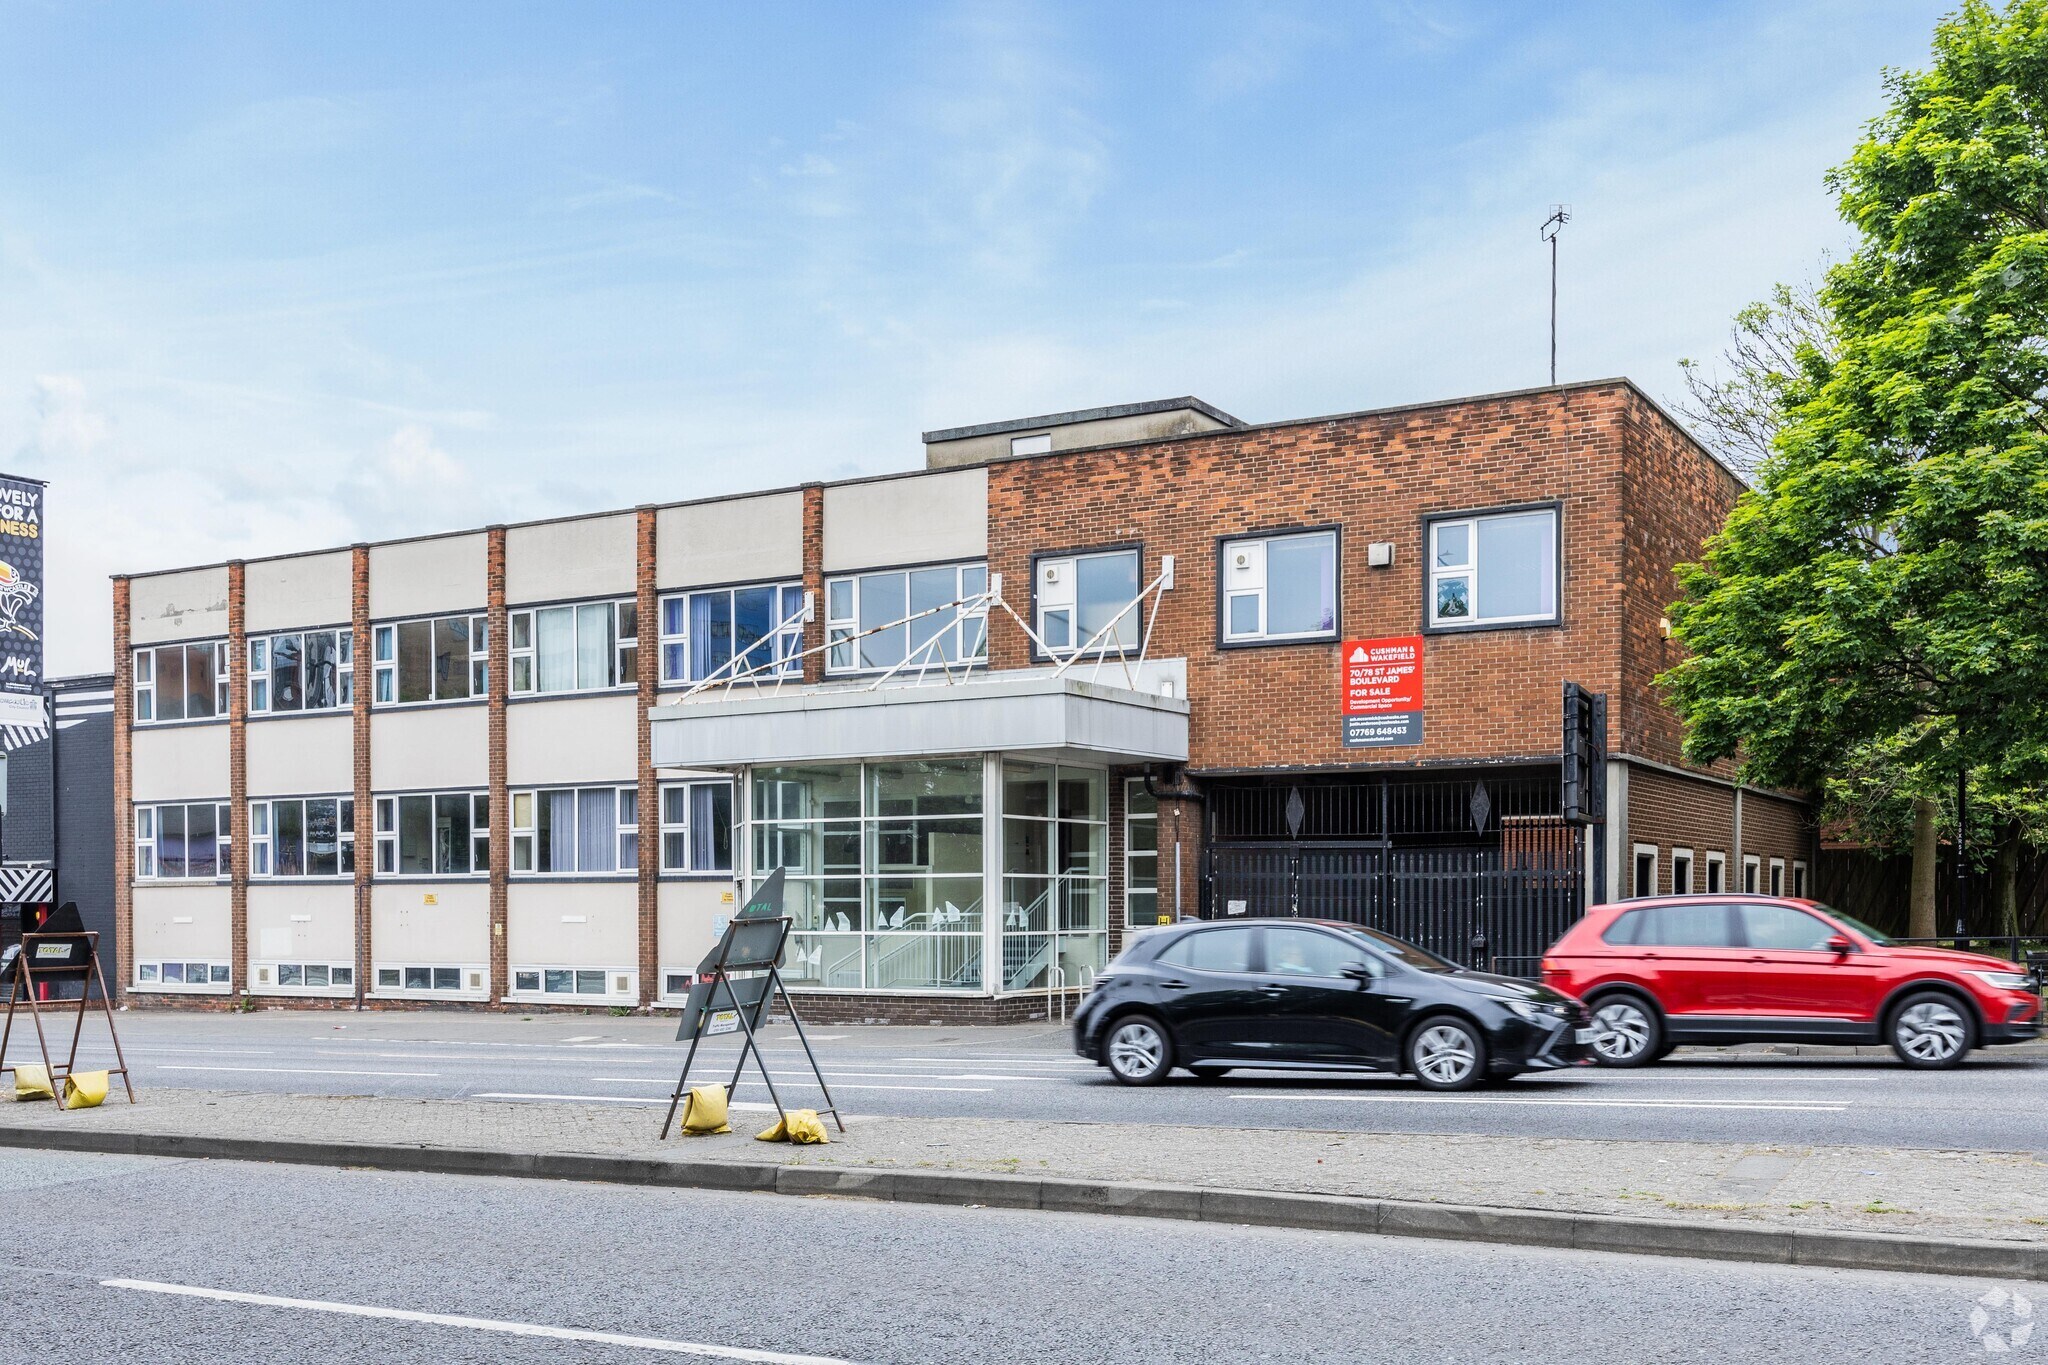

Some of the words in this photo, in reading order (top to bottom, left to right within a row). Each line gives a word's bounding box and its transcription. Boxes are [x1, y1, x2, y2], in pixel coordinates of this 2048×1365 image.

[0, 487, 39, 508] VELY
[0, 503, 24, 521] OR
[27, 508, 39, 524] A
[1370, 646, 1408, 655] CUSHMAN
[1370, 652, 1415, 662] WAKEFIELD
[1350, 668, 1373, 678] 70/78
[1375, 667, 1385, 676] ST
[1350, 675, 1400, 686] BOULEVARD
[1350, 689, 1367, 698] FOR
[1369, 687, 1391, 697] SALE
[1350, 728, 1375, 737] 07769
[1376, 726, 1407, 736] 648453
